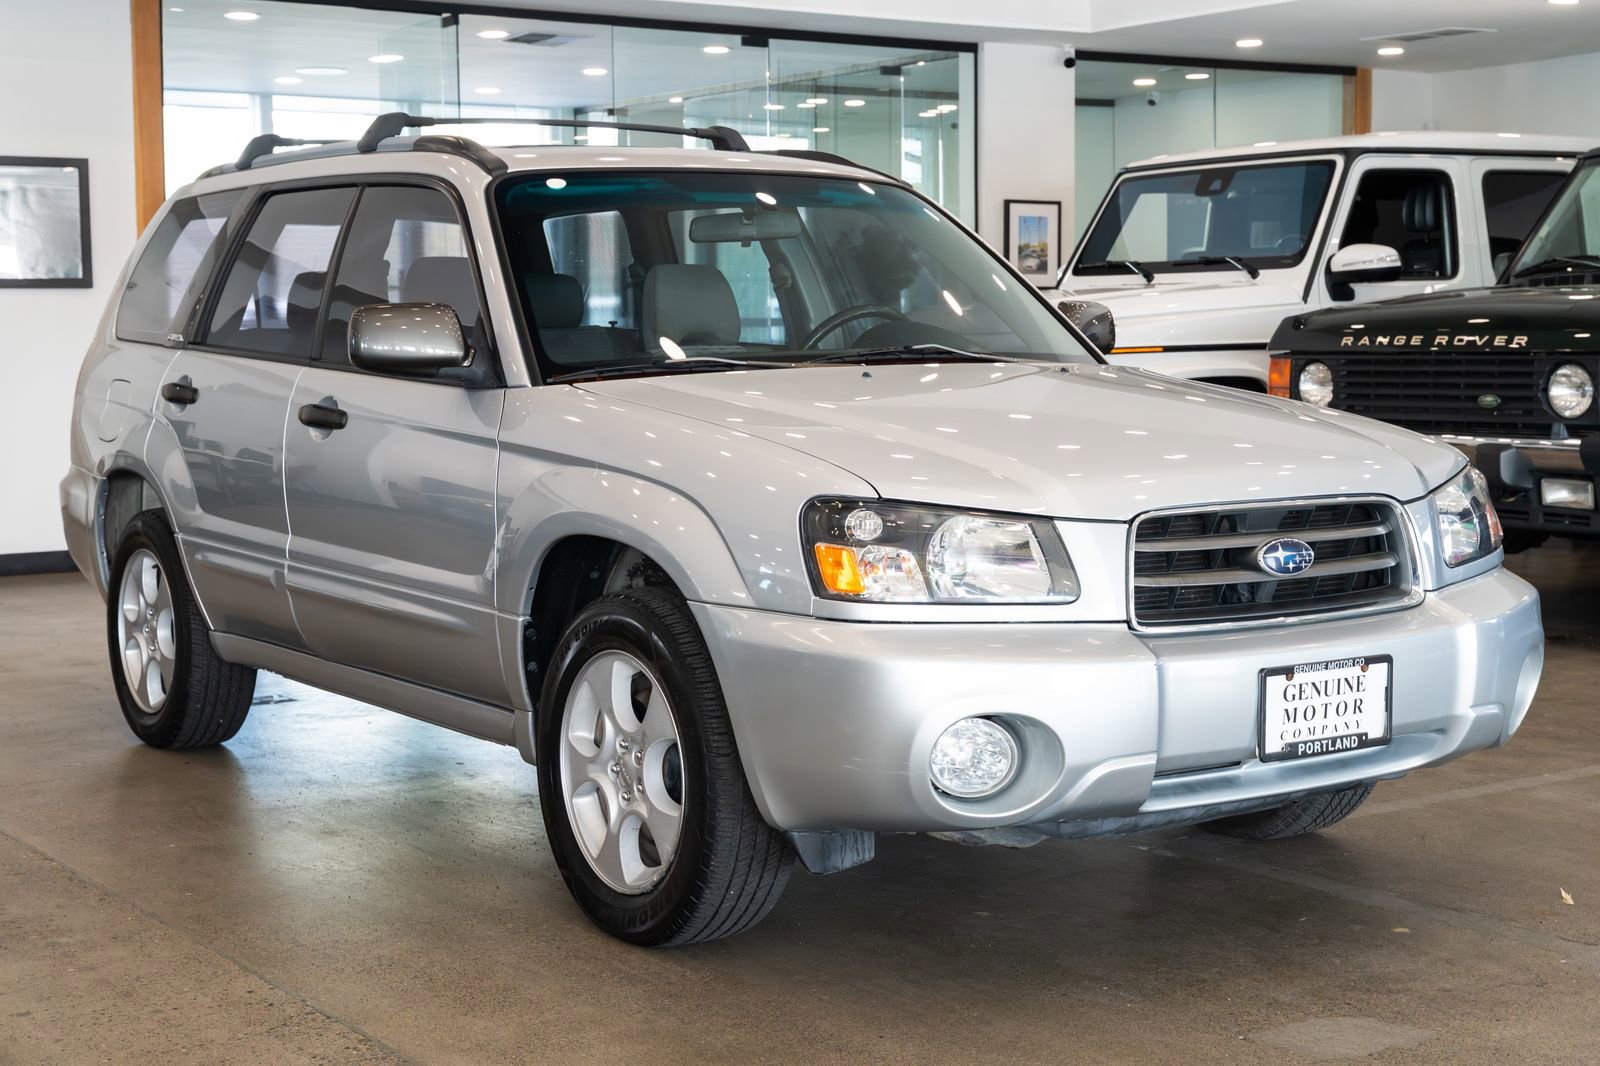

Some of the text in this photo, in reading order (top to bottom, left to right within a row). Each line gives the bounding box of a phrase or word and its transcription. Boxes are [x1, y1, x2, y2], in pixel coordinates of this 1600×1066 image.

[1340, 335, 1528, 347] RANGE ROVER
[1293, 657, 1365, 675] GENUINE MOTOR CO
[1283, 674, 1366, 703] GENUINE
[1282, 698, 1363, 725] MOTOR
[1280, 719, 1362, 741] COMPANY
[1298, 735, 1359, 756] PORTLAND
